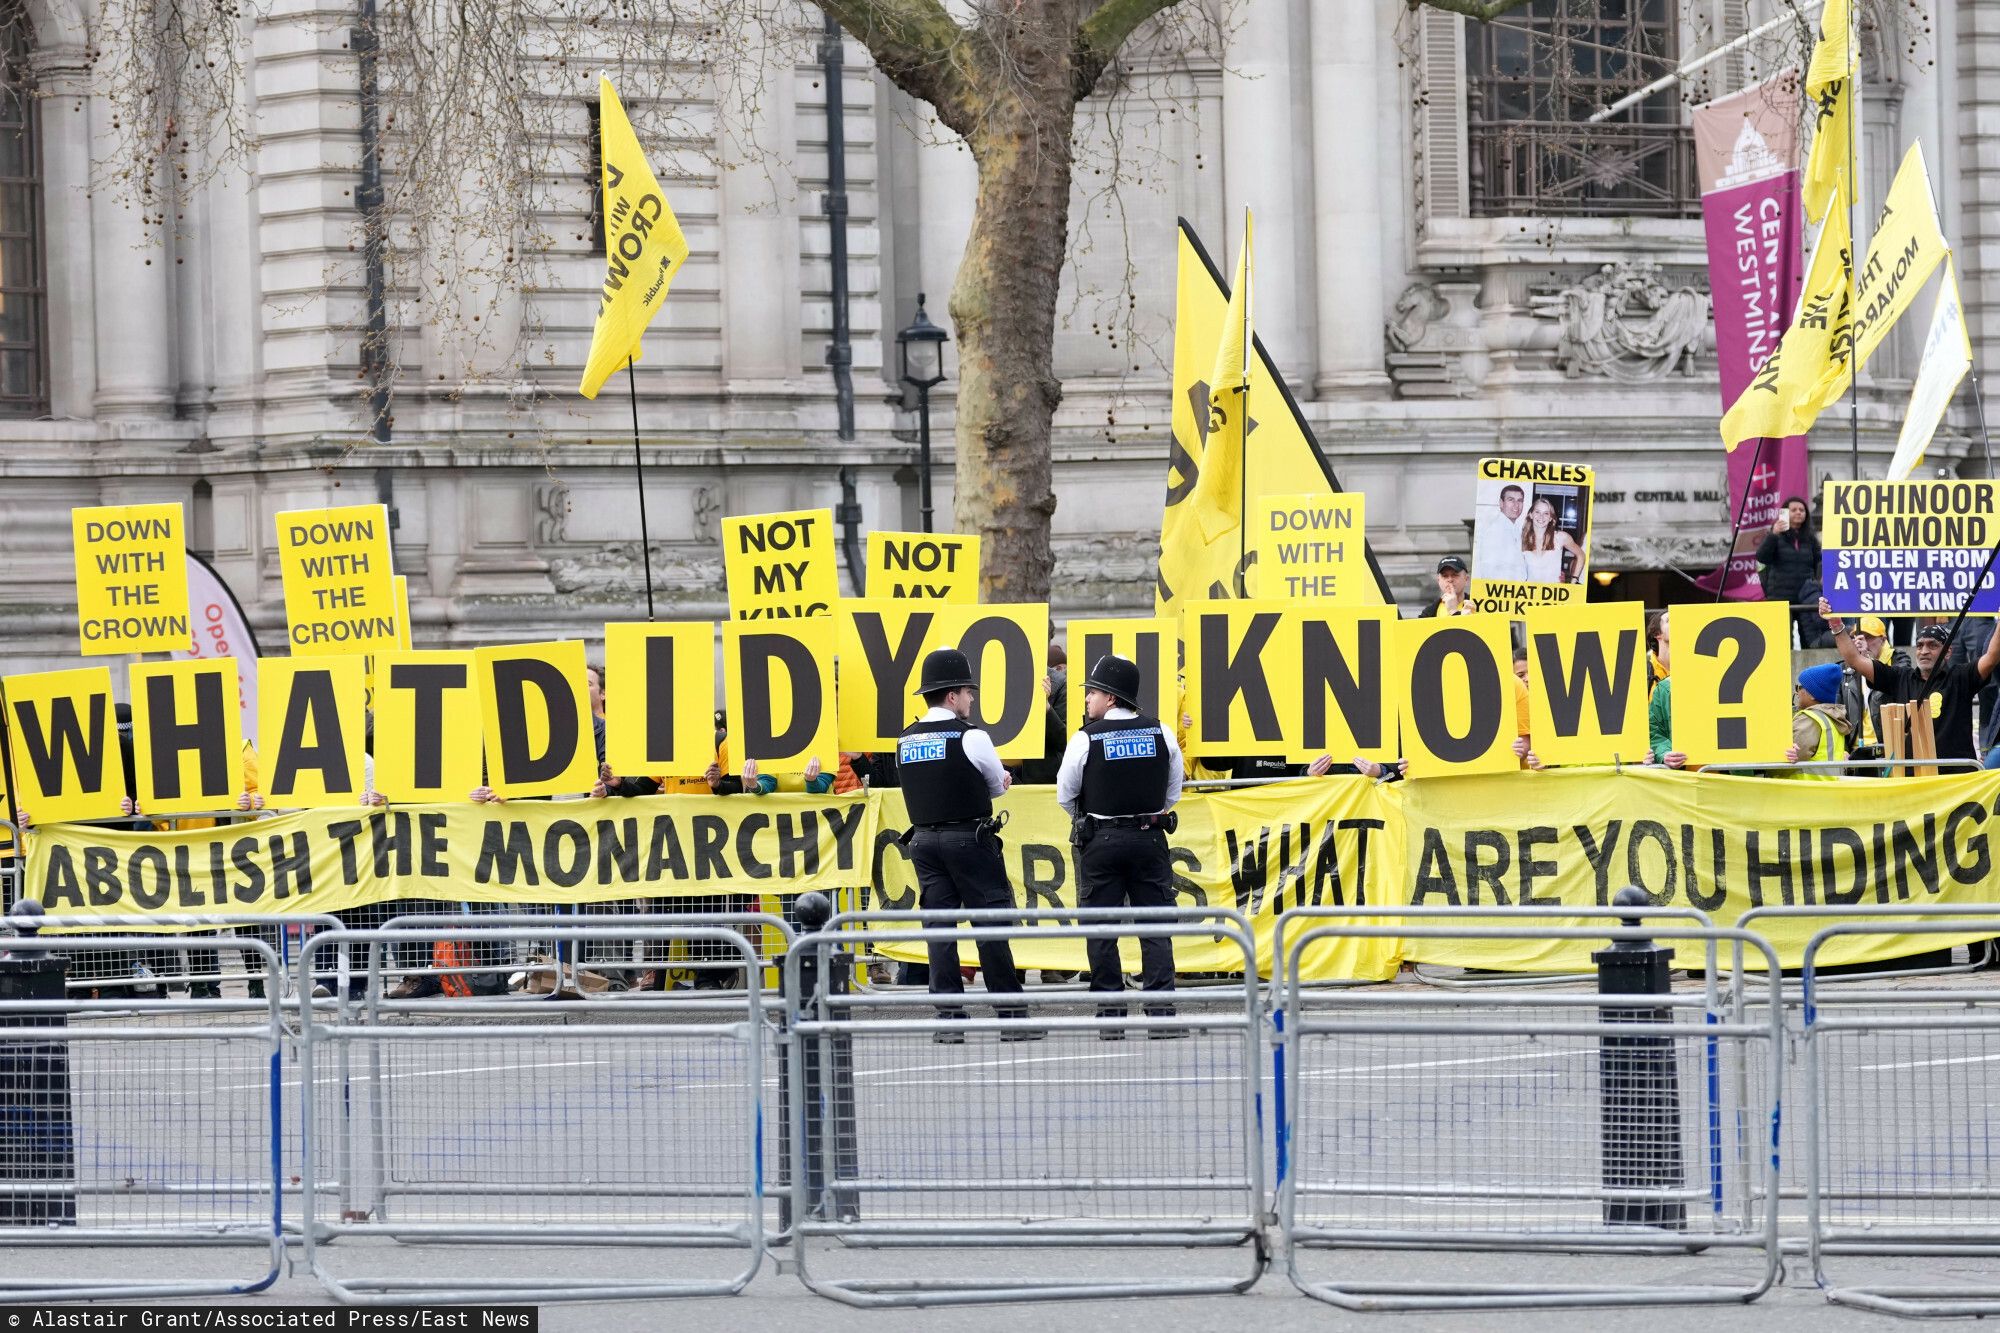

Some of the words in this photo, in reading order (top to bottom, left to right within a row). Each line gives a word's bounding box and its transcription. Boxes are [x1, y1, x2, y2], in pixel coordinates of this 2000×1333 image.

[1733, 202, 1772, 373] WESTMINS
[1483, 459, 1586, 482] CHARLES
[1634, 491, 1687, 503] CENTRAL
[1693, 490, 1719, 502] HALL
[1833, 484, 1994, 514] KOHINOOR
[86, 518, 171, 543] DOWN
[1270, 508, 1352, 531] DOWN
[290, 520, 374, 546] DOWN
[739, 518, 815, 553] NOT
[1841, 517, 1986, 547] DIAMOND
[96, 551, 165, 574] WITH
[884, 541, 962, 572] NOT
[1277, 542, 1344, 564] WITH
[1838, 550, 1919, 569] STOLEN
[1927, 550, 1990, 568] FROM
[301, 552, 370, 579] WITH
[754, 561, 810, 595] MY
[1285, 575, 1336, 597] THE
[1834, 572, 1849, 589] A
[1856, 572, 1883, 589] 10
[1889, 572, 1946, 589] YEAR
[106, 584, 160, 606] THE
[312, 586, 366, 610] THE
[1486, 583, 1537, 600] WHAT
[1542, 587, 1570, 601] DID
[1860, 593, 1912, 611] SIKH
[1919, 592, 1973, 611] KING
[83, 615, 187, 640] CROWN
[292, 617, 394, 645] CROWN
[902, 747, 945, 762] POLICE
[1106, 743, 1155, 758] POLICE
[42, 831, 312, 909] ABOLISH
[327, 812, 448, 886] THE
[474, 803, 865, 887] MONARCHY
[1225, 819, 1385, 916] WHAT
[1410, 827, 1562, 907] ARE
[1572, 819, 1726, 912] YOU
[1746, 792, 1999, 906] HIDING
